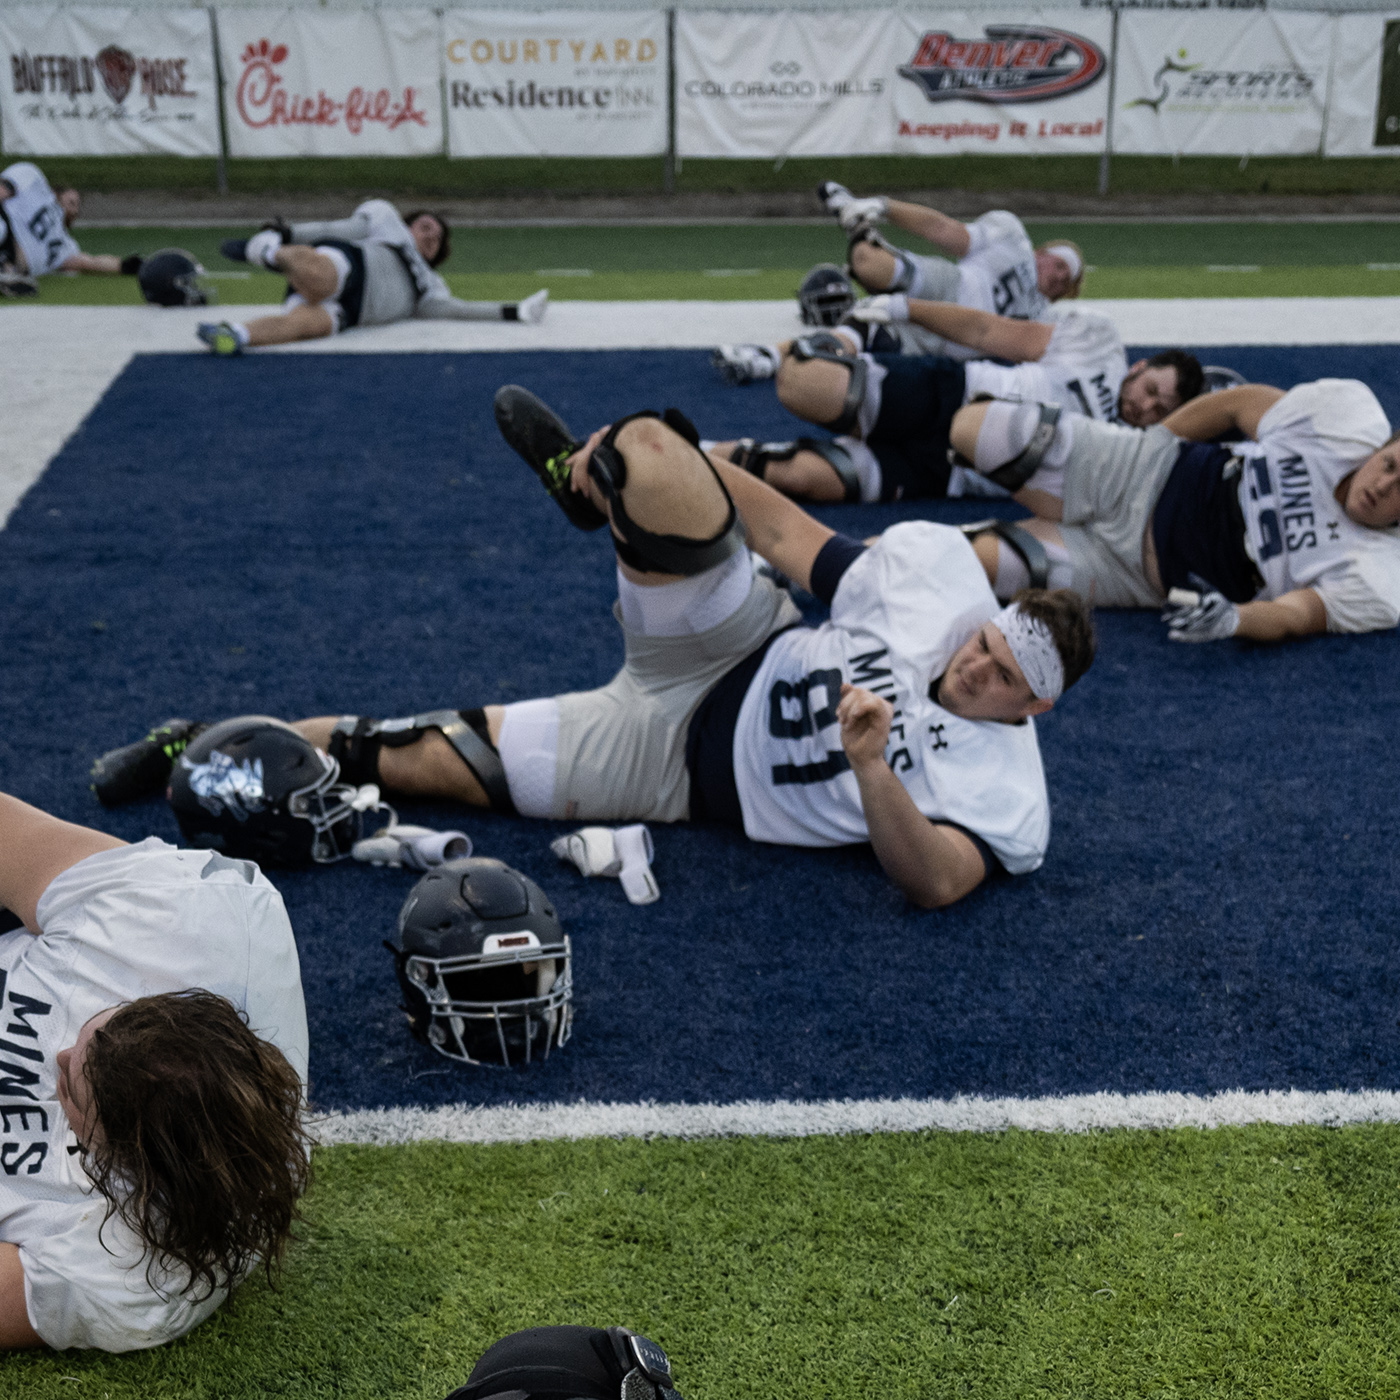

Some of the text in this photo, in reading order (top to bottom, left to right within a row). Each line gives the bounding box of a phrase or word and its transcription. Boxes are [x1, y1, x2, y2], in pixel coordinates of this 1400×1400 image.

[448, 38, 658, 64] COURTYARD
[910, 34, 1064, 68] Denver
[236, 60, 429, 136] Chick-fil-A
[451, 79, 611, 109] Residence
[684, 78, 885, 98] COLORADO MILLS
[1278, 455, 1317, 552] MINES
[769, 668, 854, 785] 81
